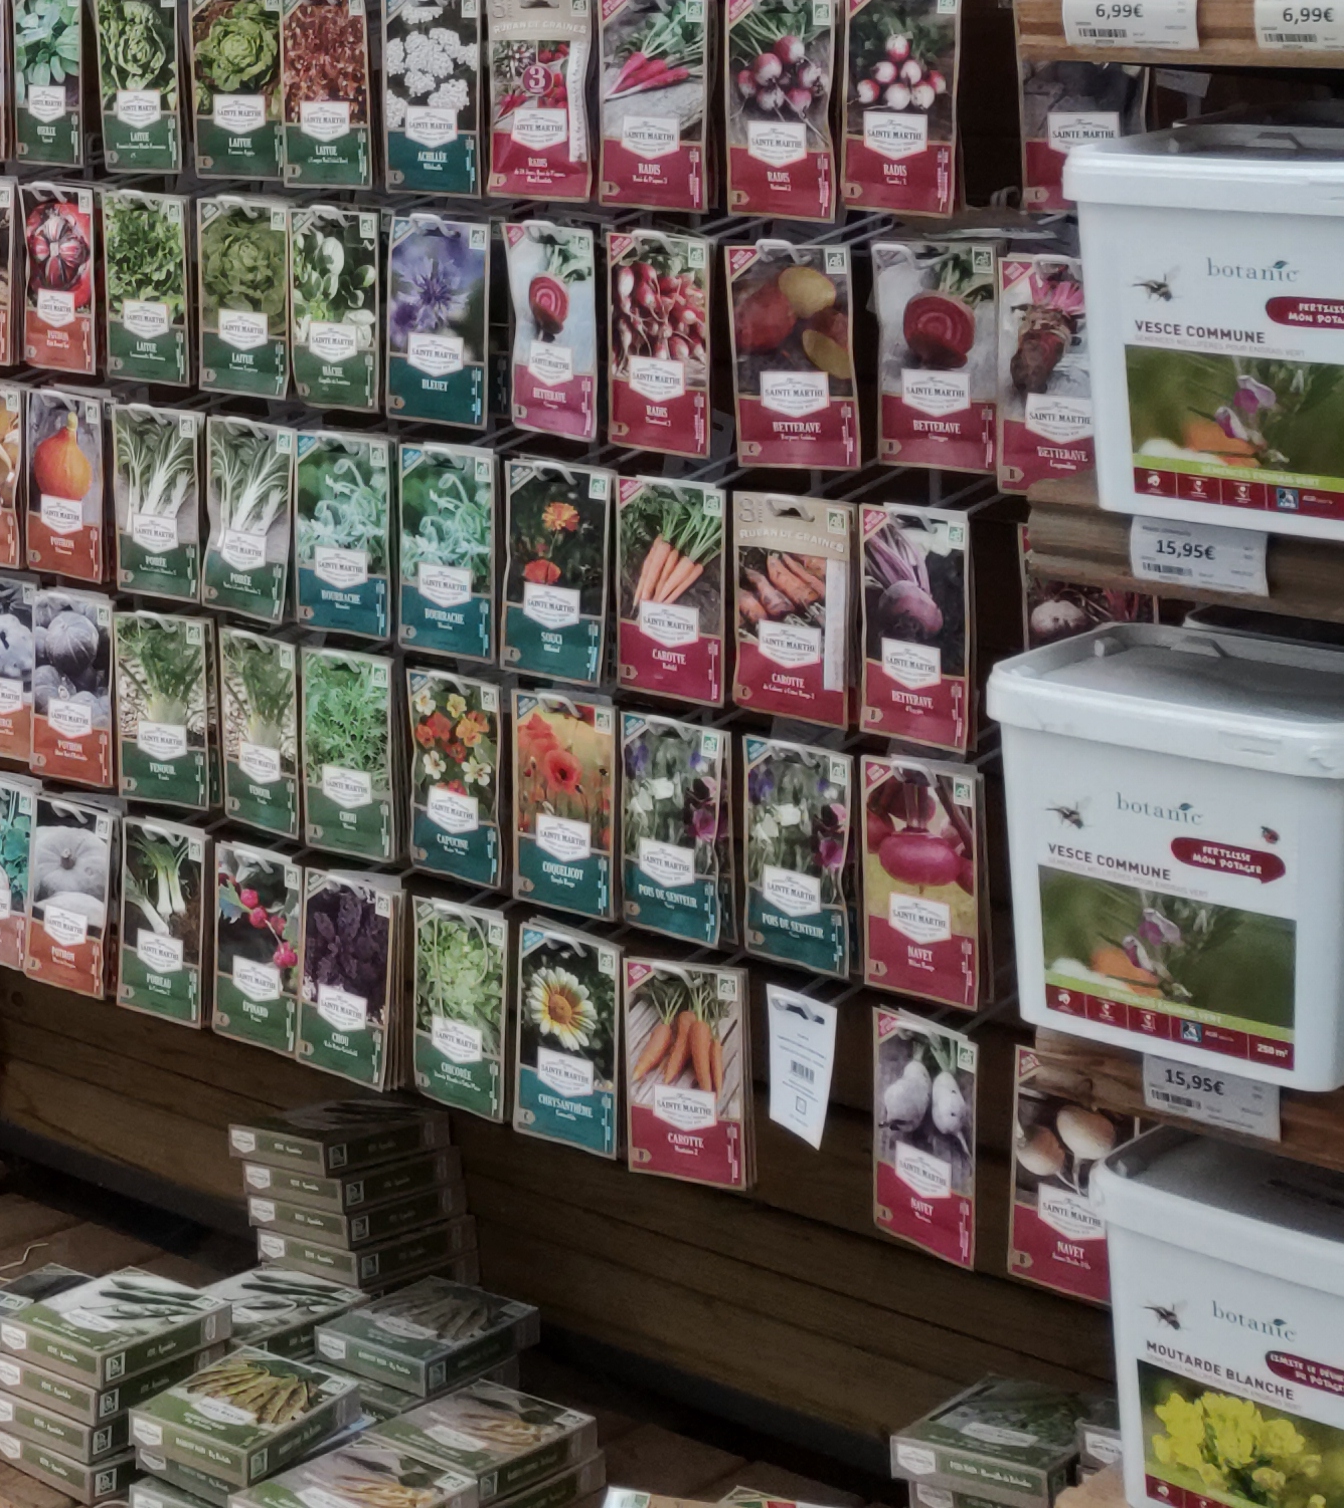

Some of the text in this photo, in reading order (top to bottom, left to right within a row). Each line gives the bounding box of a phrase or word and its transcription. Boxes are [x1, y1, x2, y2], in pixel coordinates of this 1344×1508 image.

[1095, 3, 1144, 19] 6,99€
[1283, 7, 1335, 25] 6,99€
[542, 20, 588, 34] GRAINES
[528, 66, 546, 88] 3
[868, 128, 924, 142] SAINTE MARTHE
[638, 163, 661, 175] RADIS
[767, 171, 790, 184] RADIS
[883, 163, 907, 177] RADIS
[1208, 258, 1299, 283] botanic
[1288, 311, 1313, 323] MON
[1134, 319, 1265, 345] VESCE COMMUNE
[773, 421, 821, 434] BETTERAVE
[914, 420, 961, 435] BETTERAVE
[1037, 446, 1089, 463] BETTERAVE
[795, 533, 845, 553] GRAINES
[1156, 539, 1216, 561] 15,95€
[653, 649, 687, 665] CAROTTE
[772, 674, 805, 689] CAROTTE
[892, 691, 934, 710] BETTERAVE
[1116, 792, 1203, 826] botanic
[1048, 842, 1093, 864] VESCE
[1097, 854, 1171, 882] COMMUNE
[1193, 853, 1263, 875] MON POTAGER
[908, 945, 933, 962] NAVET
[1165, 1068, 1225, 1096] 15,95€
[667, 1132, 705, 1149] CAROTTE
[912, 1198, 934, 1217] NAVET
[1042, 1202, 1102, 1226] SAINTE MARTHE
[1057, 1241, 1085, 1259] NAVET
[1212, 1300, 1297, 1343] botanic
[1147, 1341, 1222, 1376] MOUTARDE
[1226, 1368, 1294, 1400] BLANCHE
